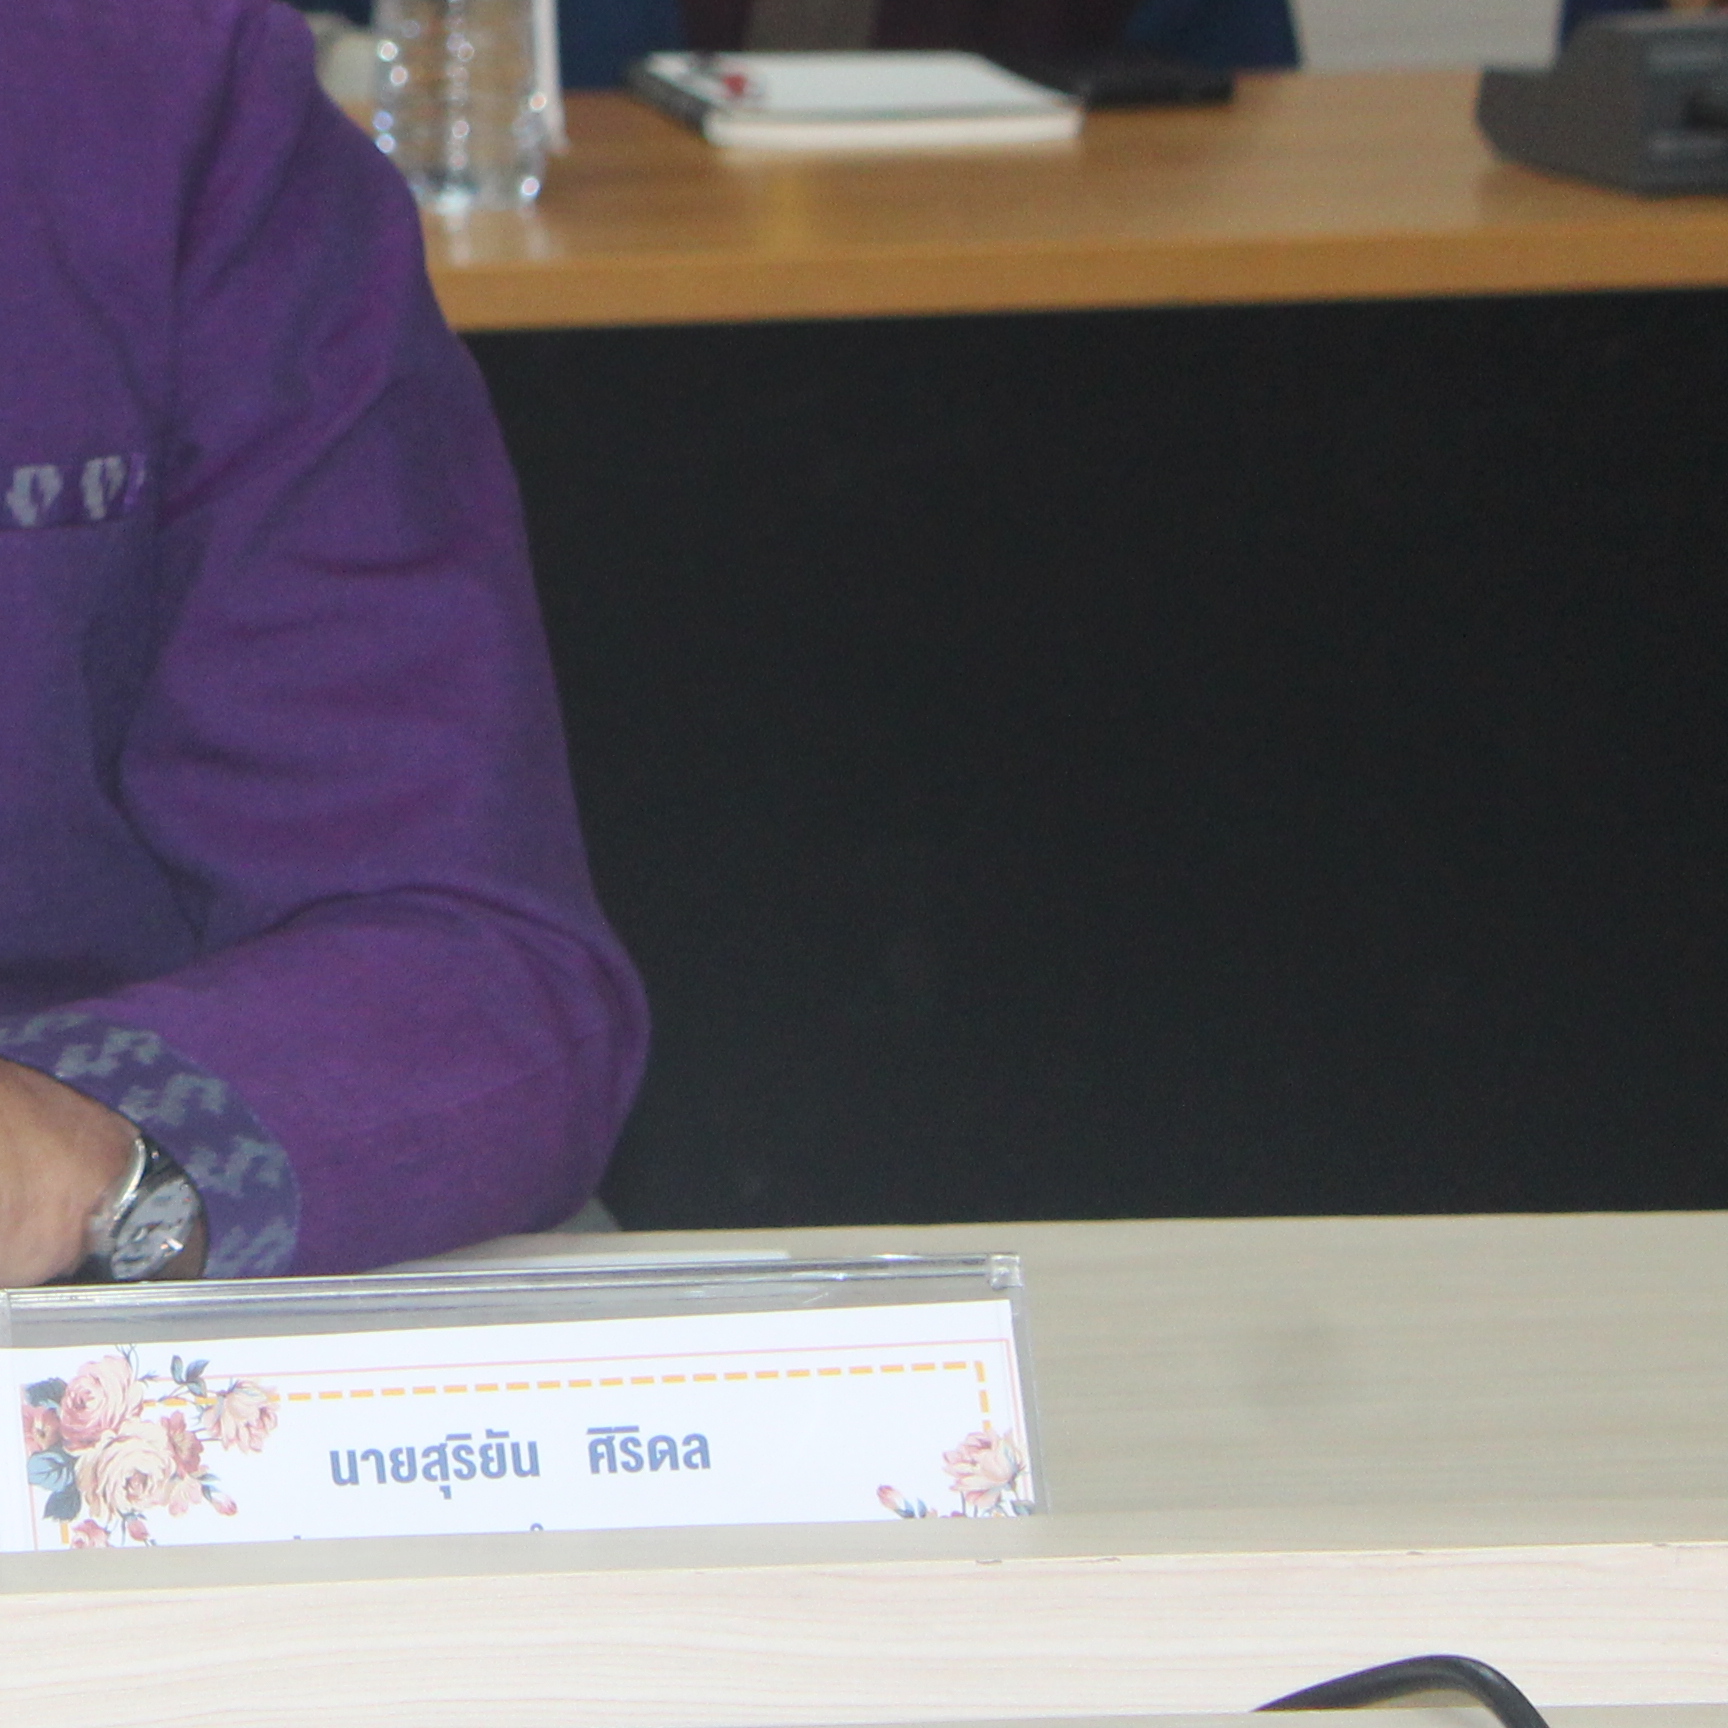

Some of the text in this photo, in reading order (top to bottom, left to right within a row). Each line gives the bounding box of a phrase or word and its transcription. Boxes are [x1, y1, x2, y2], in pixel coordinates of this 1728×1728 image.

[329, 1424, 712, 1500] นายสุริยัน ศิริดล
